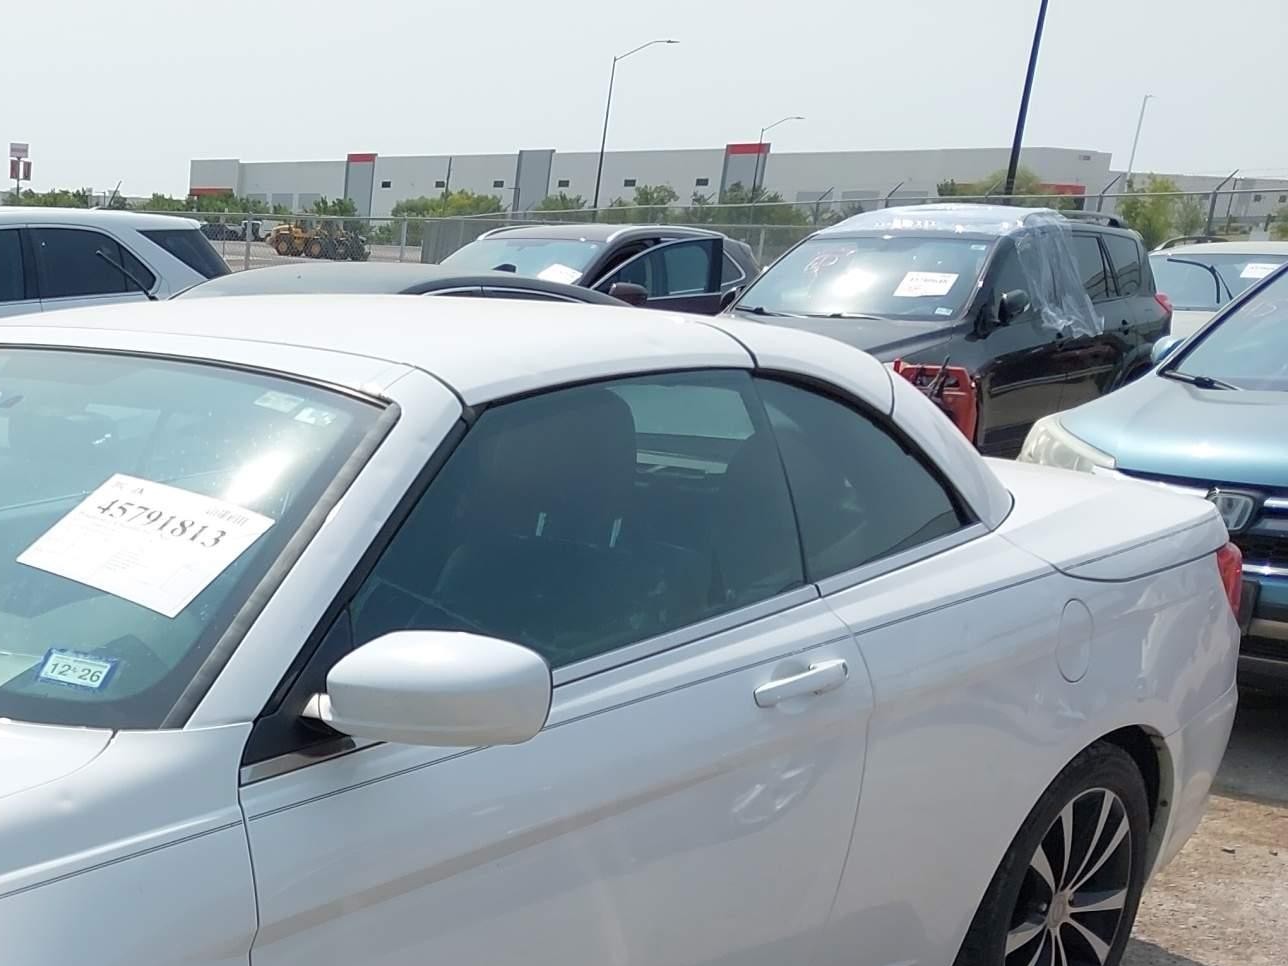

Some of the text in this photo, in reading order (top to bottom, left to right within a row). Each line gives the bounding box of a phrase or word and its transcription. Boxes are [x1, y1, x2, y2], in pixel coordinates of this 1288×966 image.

[96, 498, 227, 548] 45791813
[49, 662, 103, 683] 12 26
